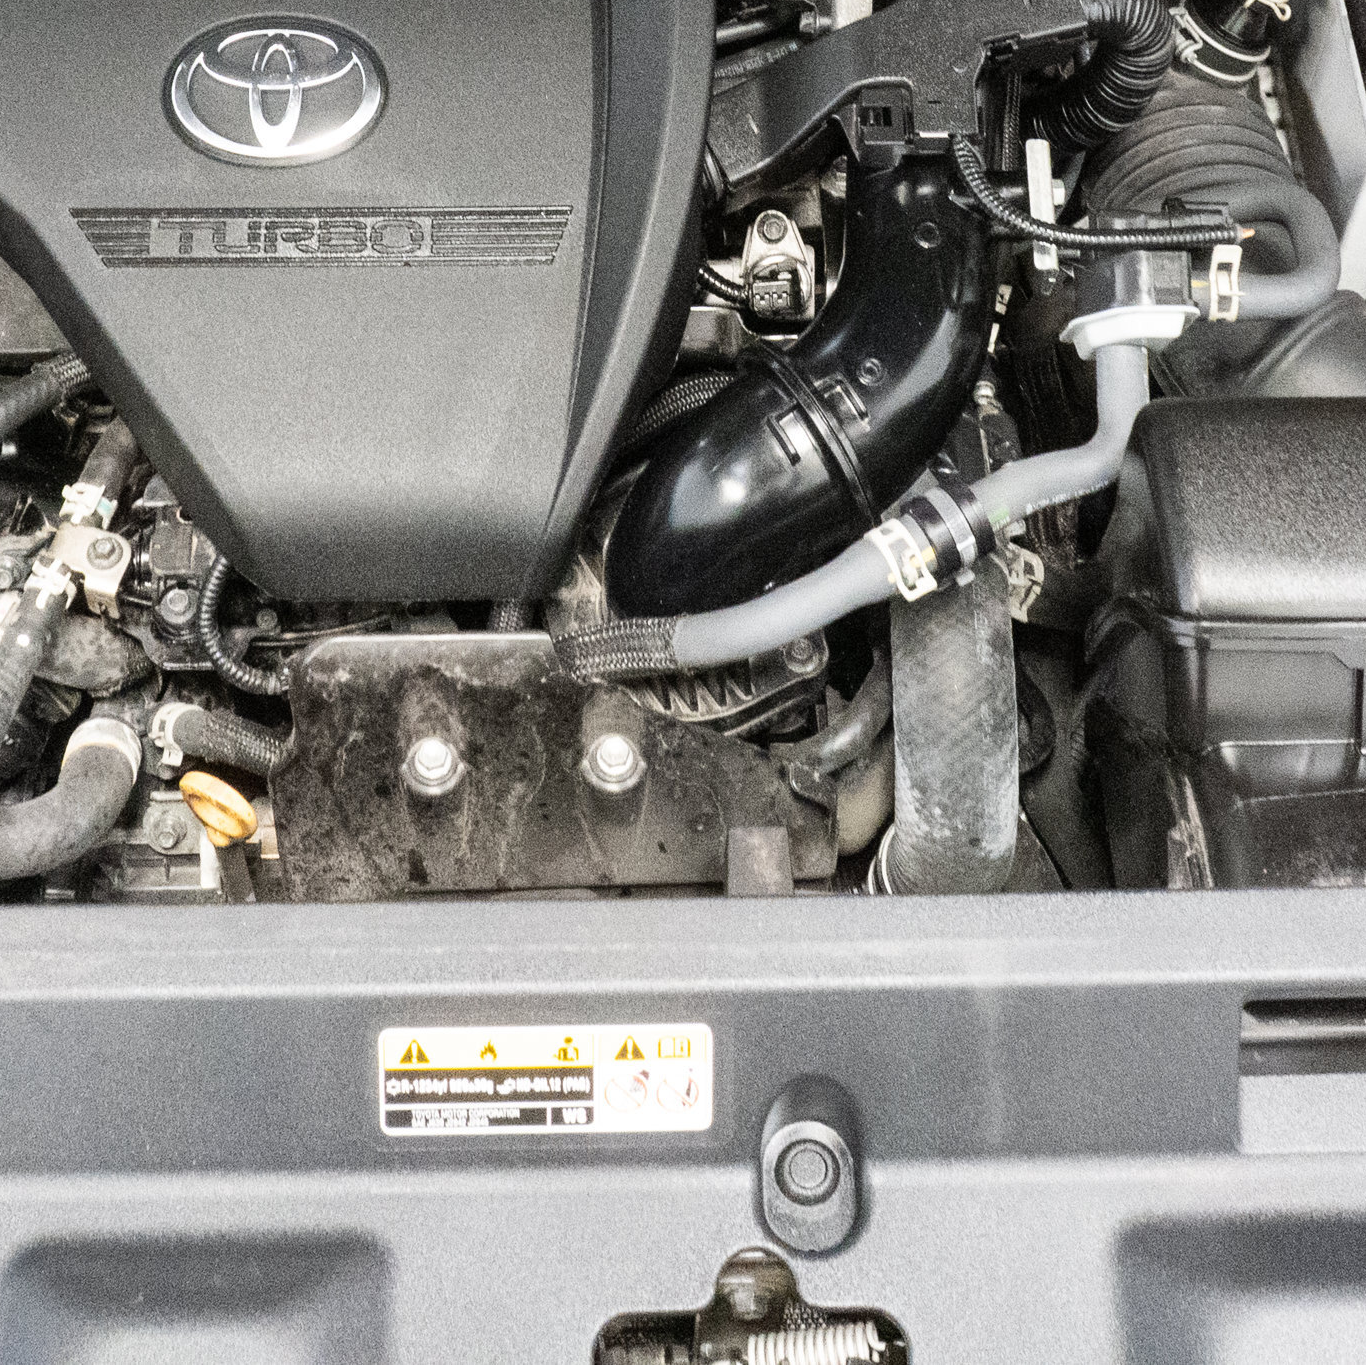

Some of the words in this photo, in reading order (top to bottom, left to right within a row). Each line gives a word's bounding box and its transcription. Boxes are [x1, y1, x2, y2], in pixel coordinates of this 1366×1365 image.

[158, 219, 425, 254] TURBO
[412, 1109, 440, 1118] TOYOTA
[441, 1109, 468, 1118] MOTOR
[469, 1108, 520, 1118] CORPORATION
